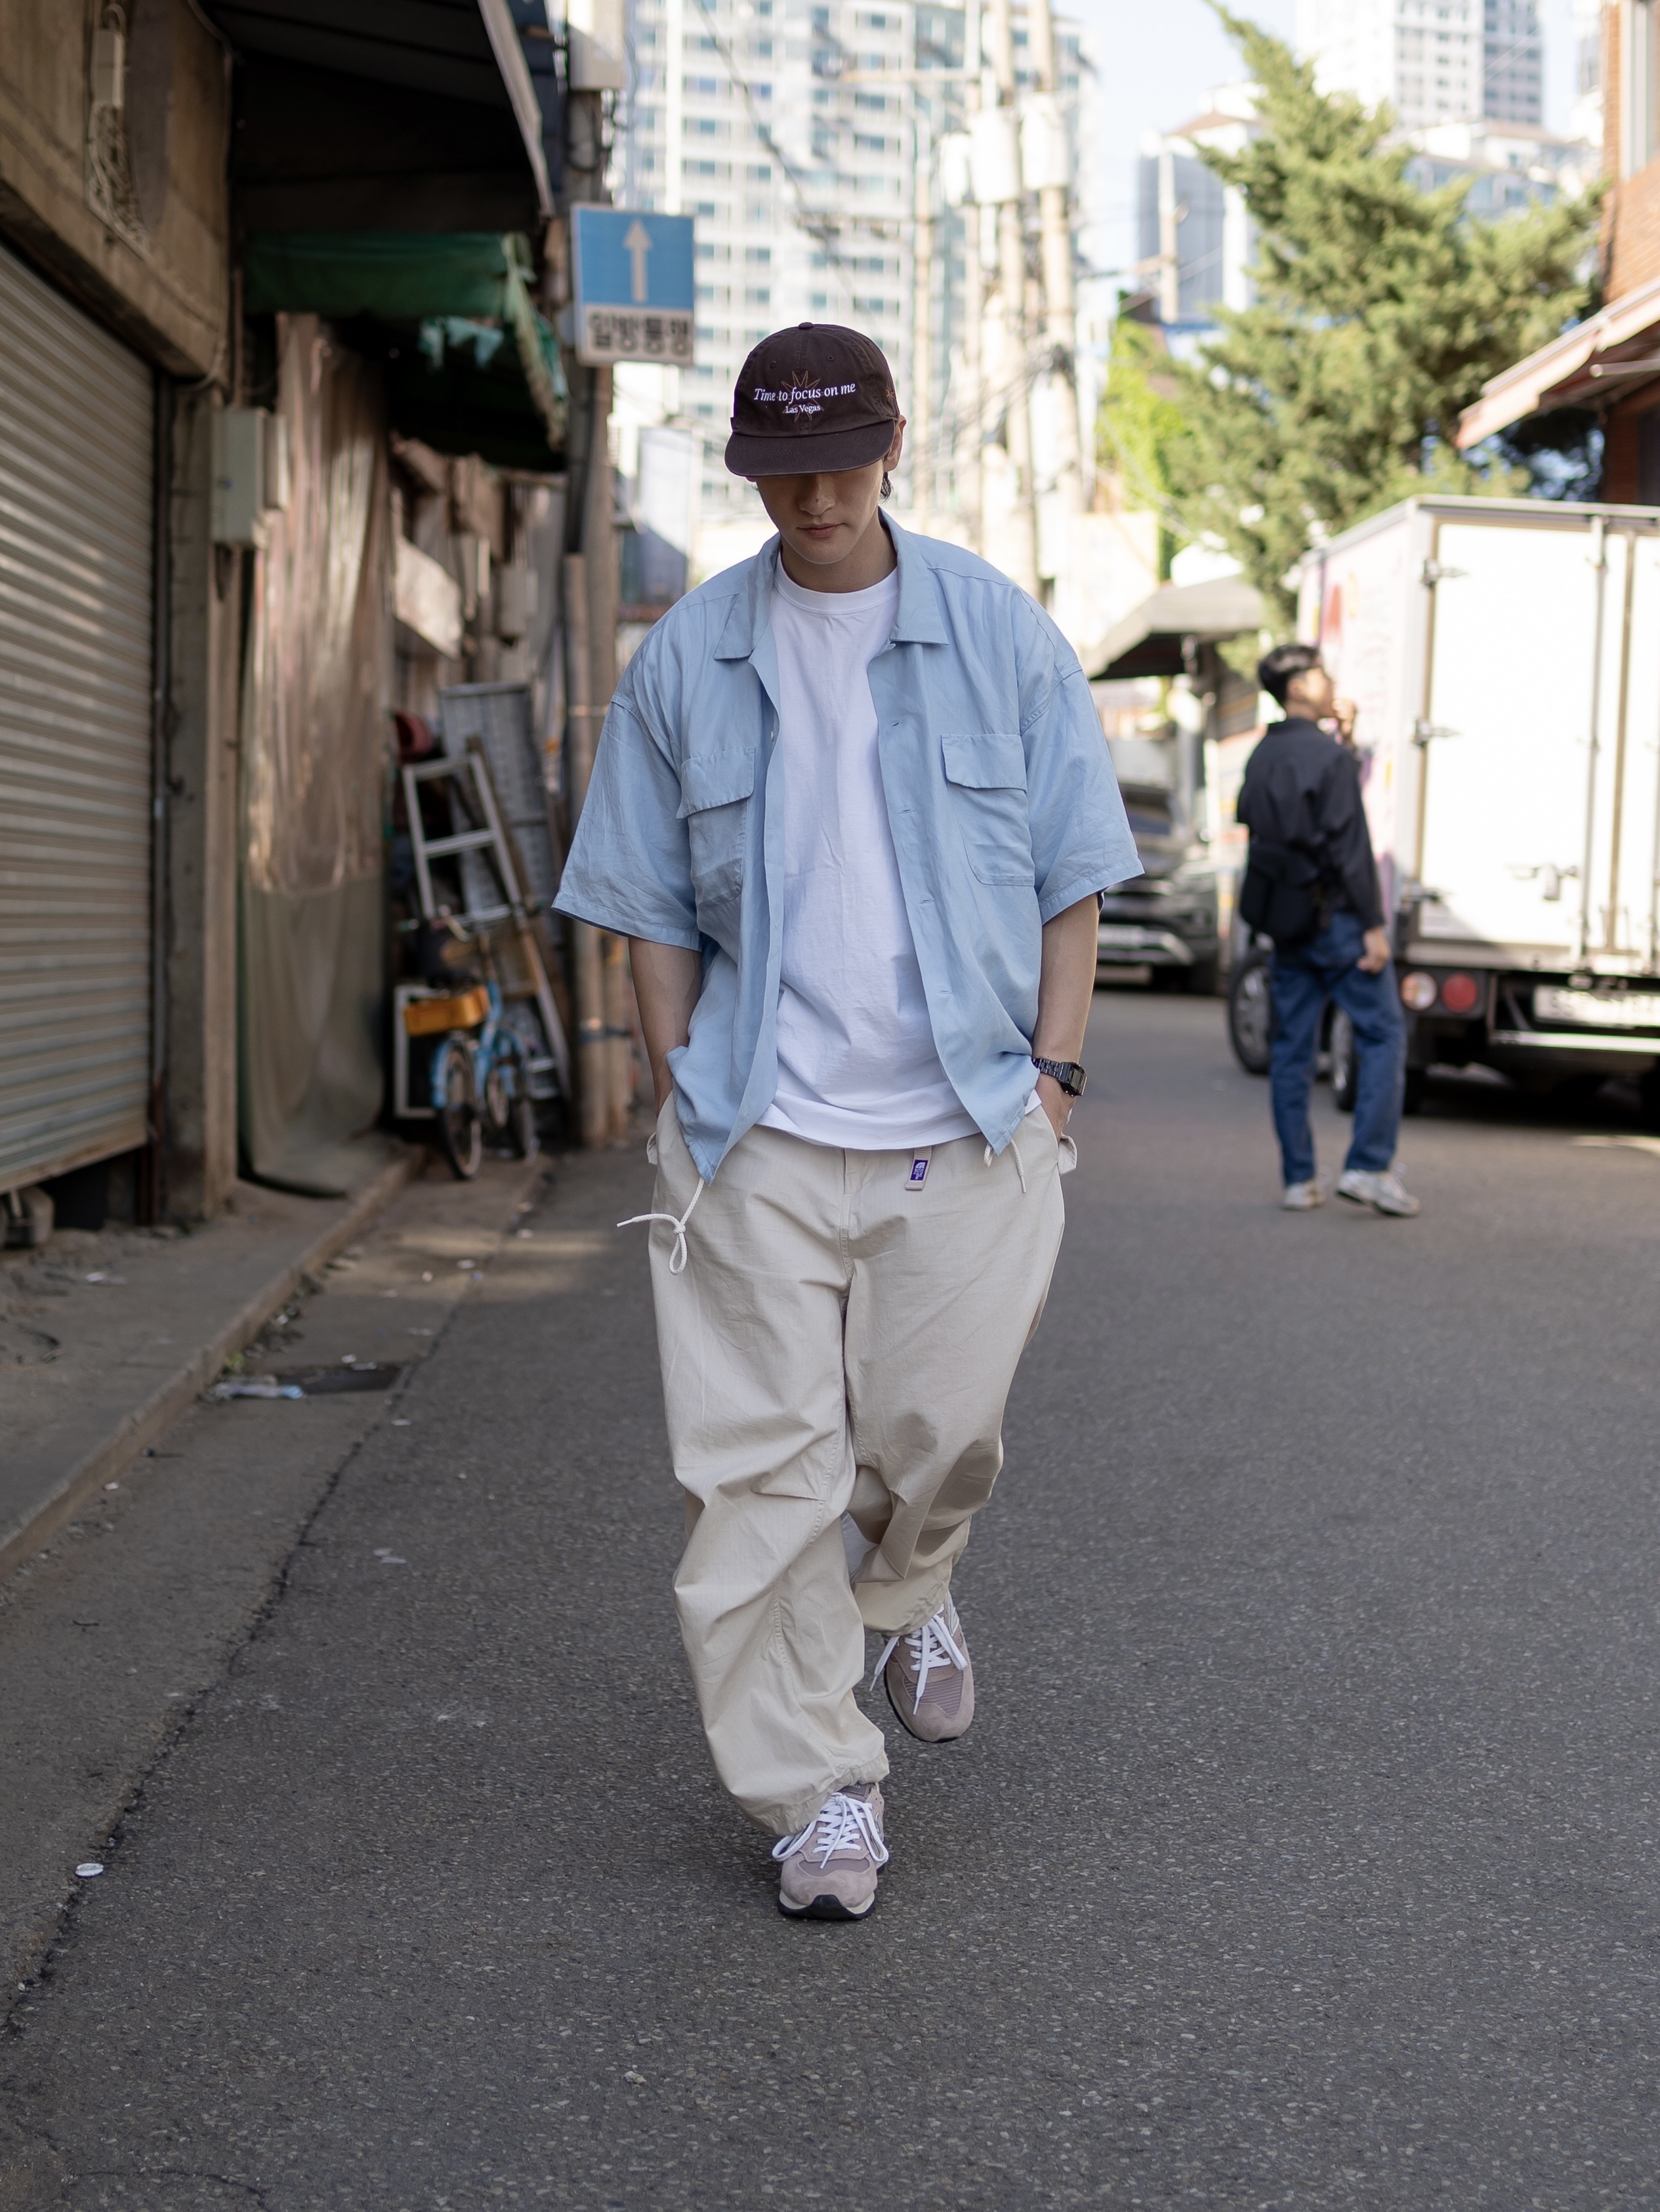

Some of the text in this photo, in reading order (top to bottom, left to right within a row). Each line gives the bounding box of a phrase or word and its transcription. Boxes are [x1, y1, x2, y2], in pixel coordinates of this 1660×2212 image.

[591, 314, 689, 357] 일방통행
[754, 382, 856, 404] Time to focus on me
[785, 404, 821, 415] Las Vegas
